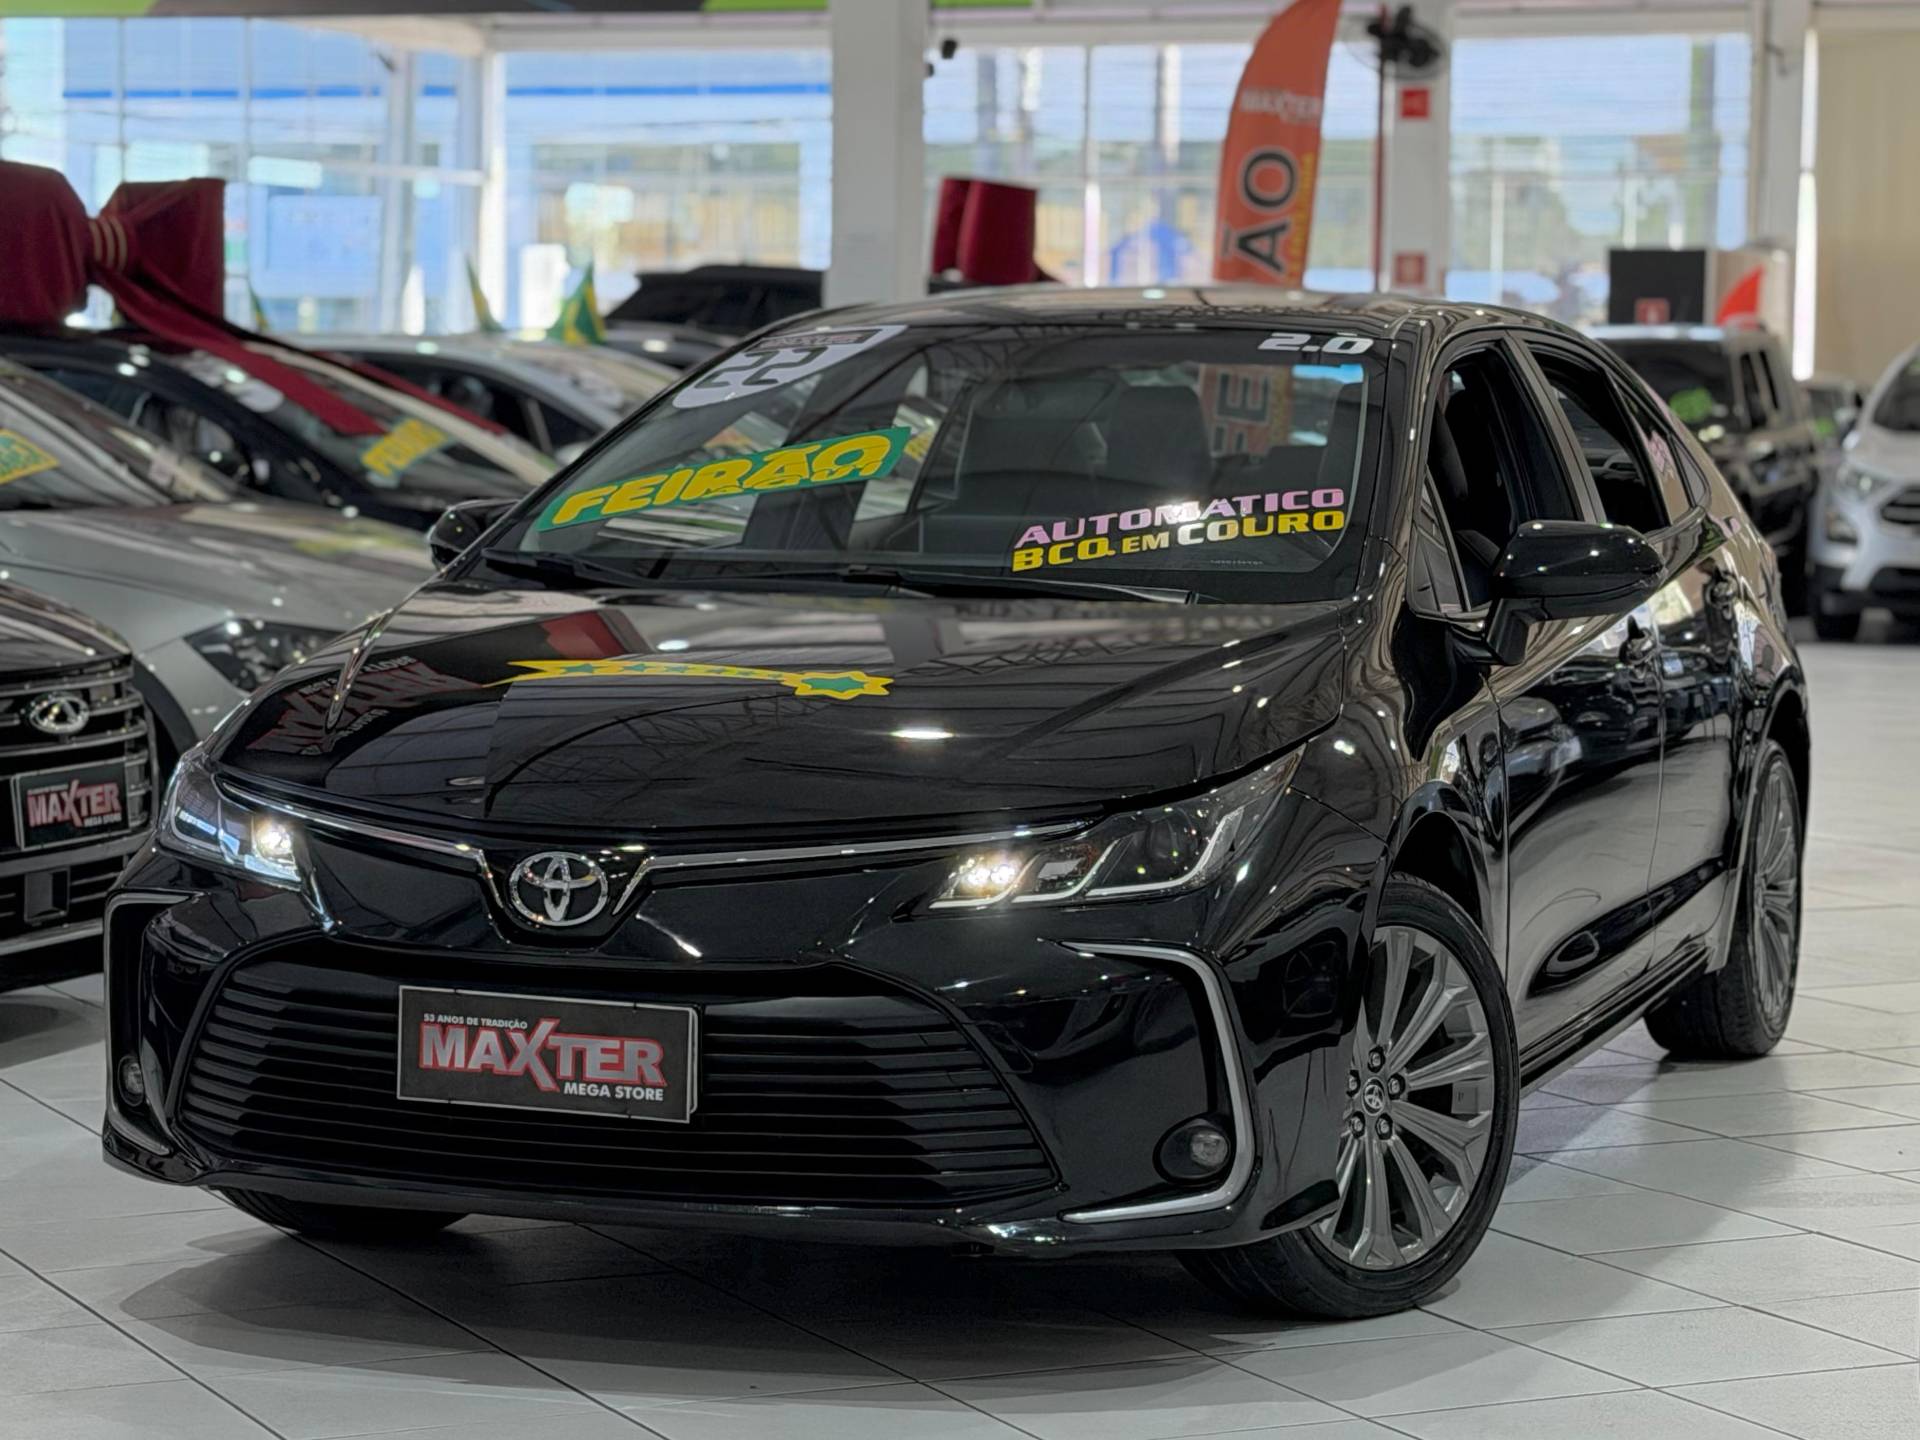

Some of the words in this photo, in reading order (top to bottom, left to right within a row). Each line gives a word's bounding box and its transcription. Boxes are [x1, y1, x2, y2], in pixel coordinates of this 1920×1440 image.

[1258, 332, 1374, 354] 2.0
[552, 434, 891, 526] FEIRÃO
[1121, 532, 1169, 554] EM
[1177, 510, 1345, 546] COURO
[27, 779, 122, 828] MAXTER
[437, 1014, 464, 1025] ANOS
[466, 1016, 479, 1026] DE
[480, 1018, 528, 1030] TRADIÇÃO
[419, 1017, 668, 1092] MAXTER
[563, 1081, 611, 1098] MEGA
[614, 1085, 664, 1101] STORE
